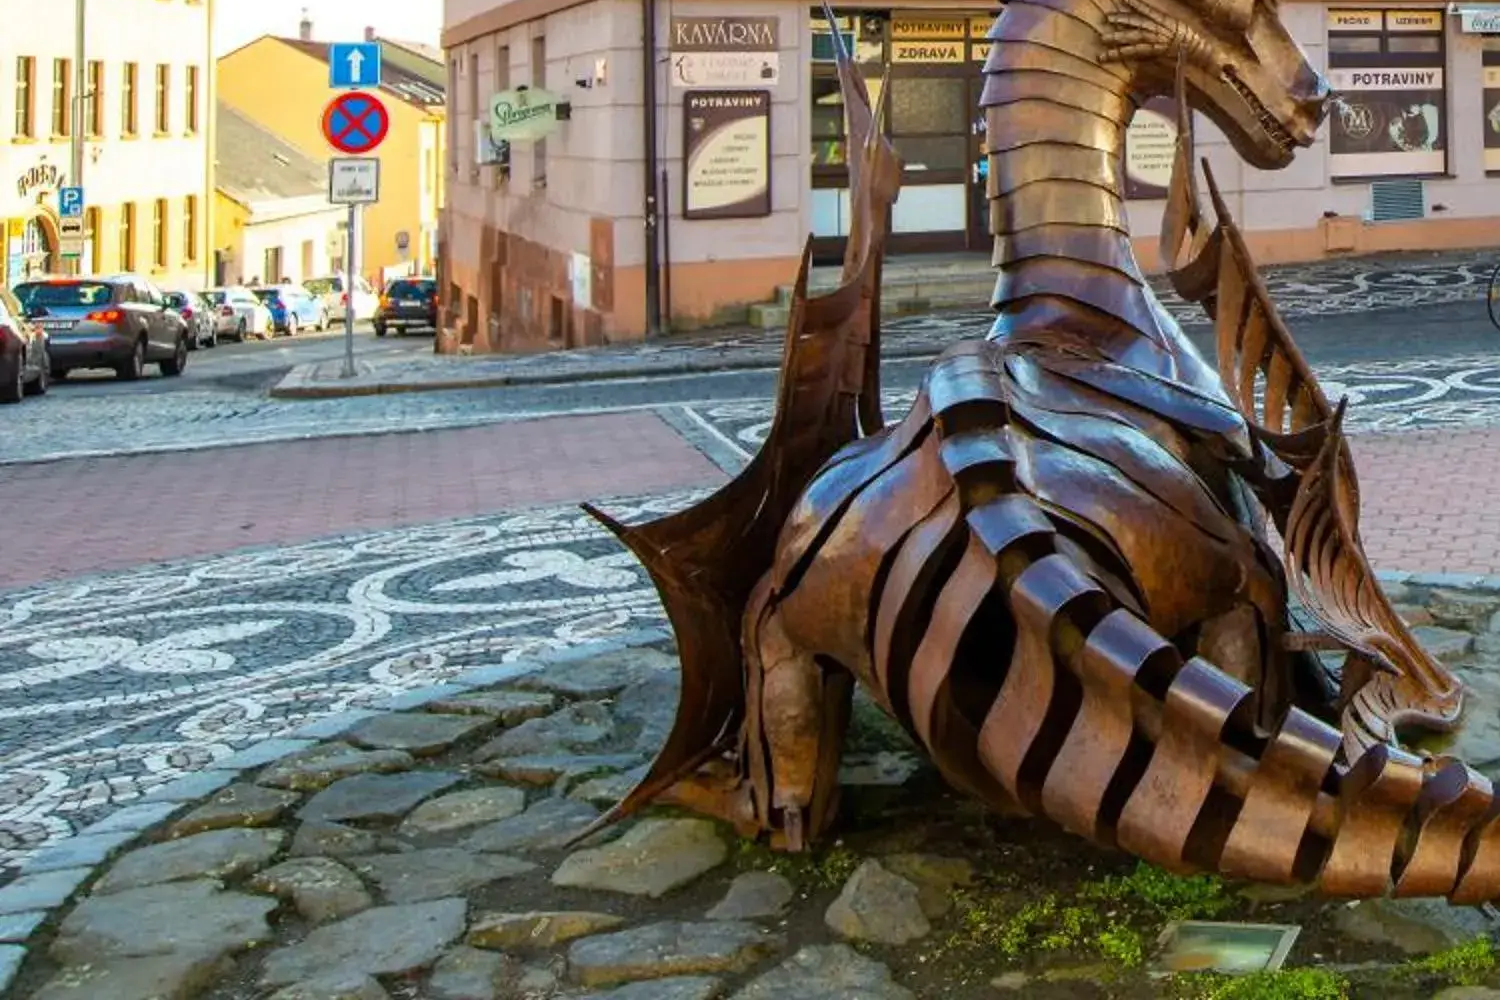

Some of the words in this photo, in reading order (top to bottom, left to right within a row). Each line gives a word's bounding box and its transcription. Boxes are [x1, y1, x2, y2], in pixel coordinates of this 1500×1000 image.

[676, 19, 773, 45] KAVÁRNA
[893, 22, 963, 33] POTRAVINY
[1352, 72, 1435, 85] POTRAVINY
[691, 96, 761, 108] POTRAVINY
[63, 189, 79, 209] P
